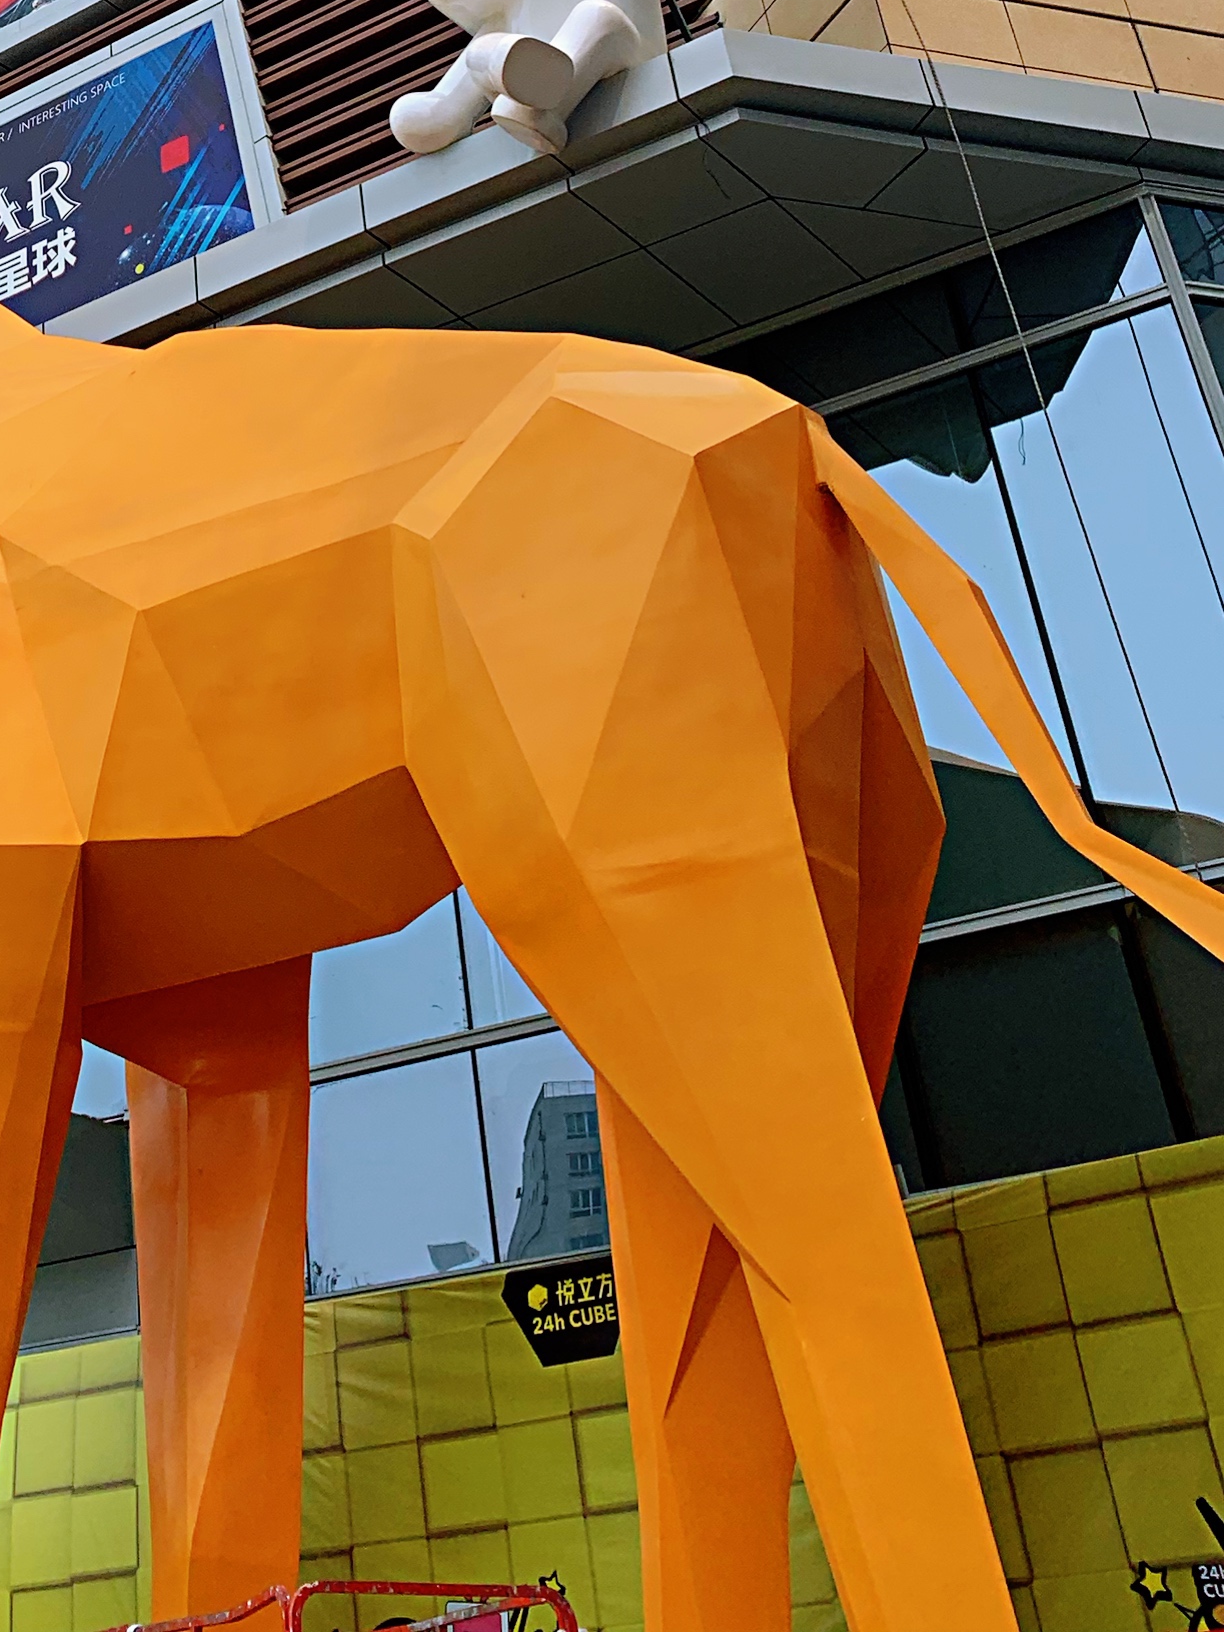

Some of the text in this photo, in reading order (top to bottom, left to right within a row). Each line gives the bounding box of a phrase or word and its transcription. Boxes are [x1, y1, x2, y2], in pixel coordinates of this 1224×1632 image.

[18, 92, 88, 134] INTERESTING
[90, 71, 126, 98] SPACE
[555, 1272, 613, 1306] 悦立方
[532, 1303, 617, 1335] 24h CUBE
